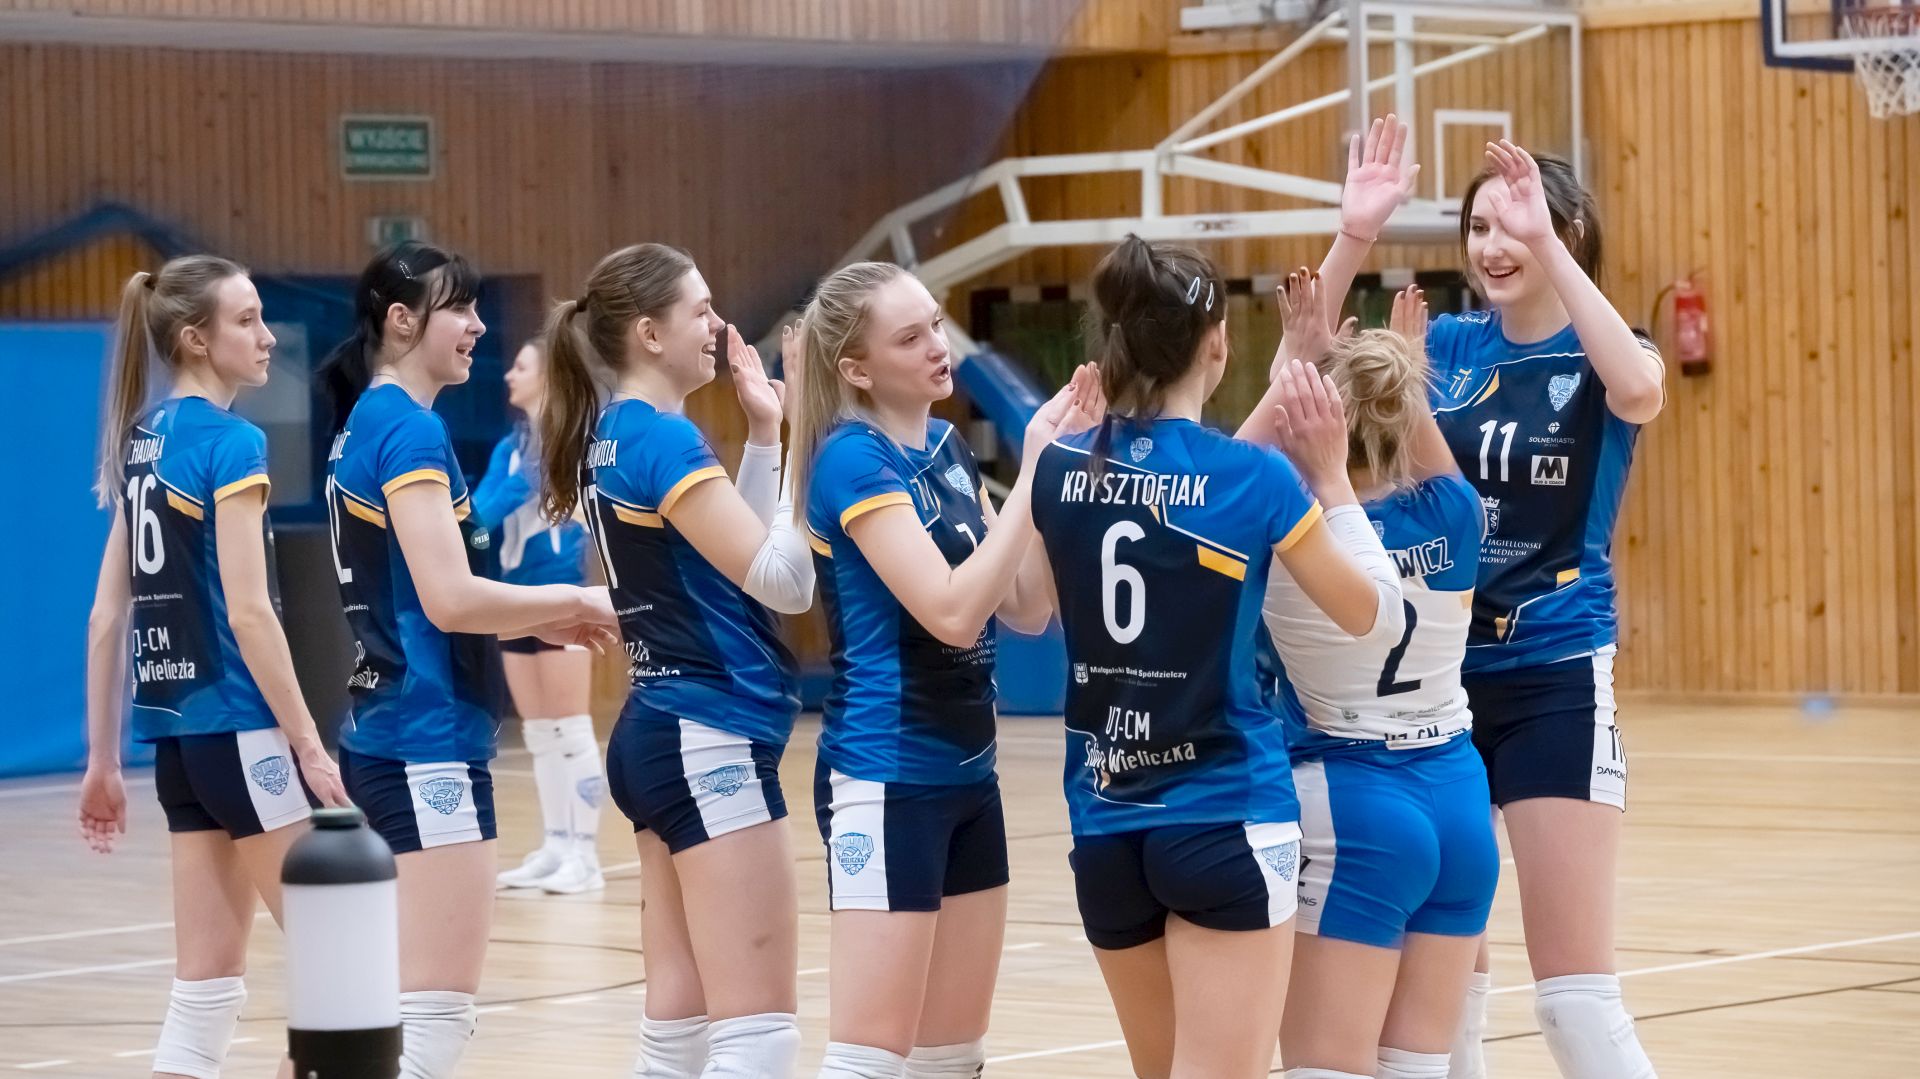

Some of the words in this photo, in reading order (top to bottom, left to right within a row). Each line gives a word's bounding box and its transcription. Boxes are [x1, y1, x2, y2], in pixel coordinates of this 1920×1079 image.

[1480, 420, 1518, 482] 11
[1061, 471, 1209, 507] KRYSZTOFIAK
[127, 474, 165, 577] 16
[1388, 537, 1454, 578] WICZ
[1101, 520, 1146, 644] 6
[1377, 598, 1421, 697] 2
[137, 657, 196, 683] Wieliczka
[1105, 706, 1150, 742] UJ-CM
[1108, 742, 1196, 773] Wieliczka
